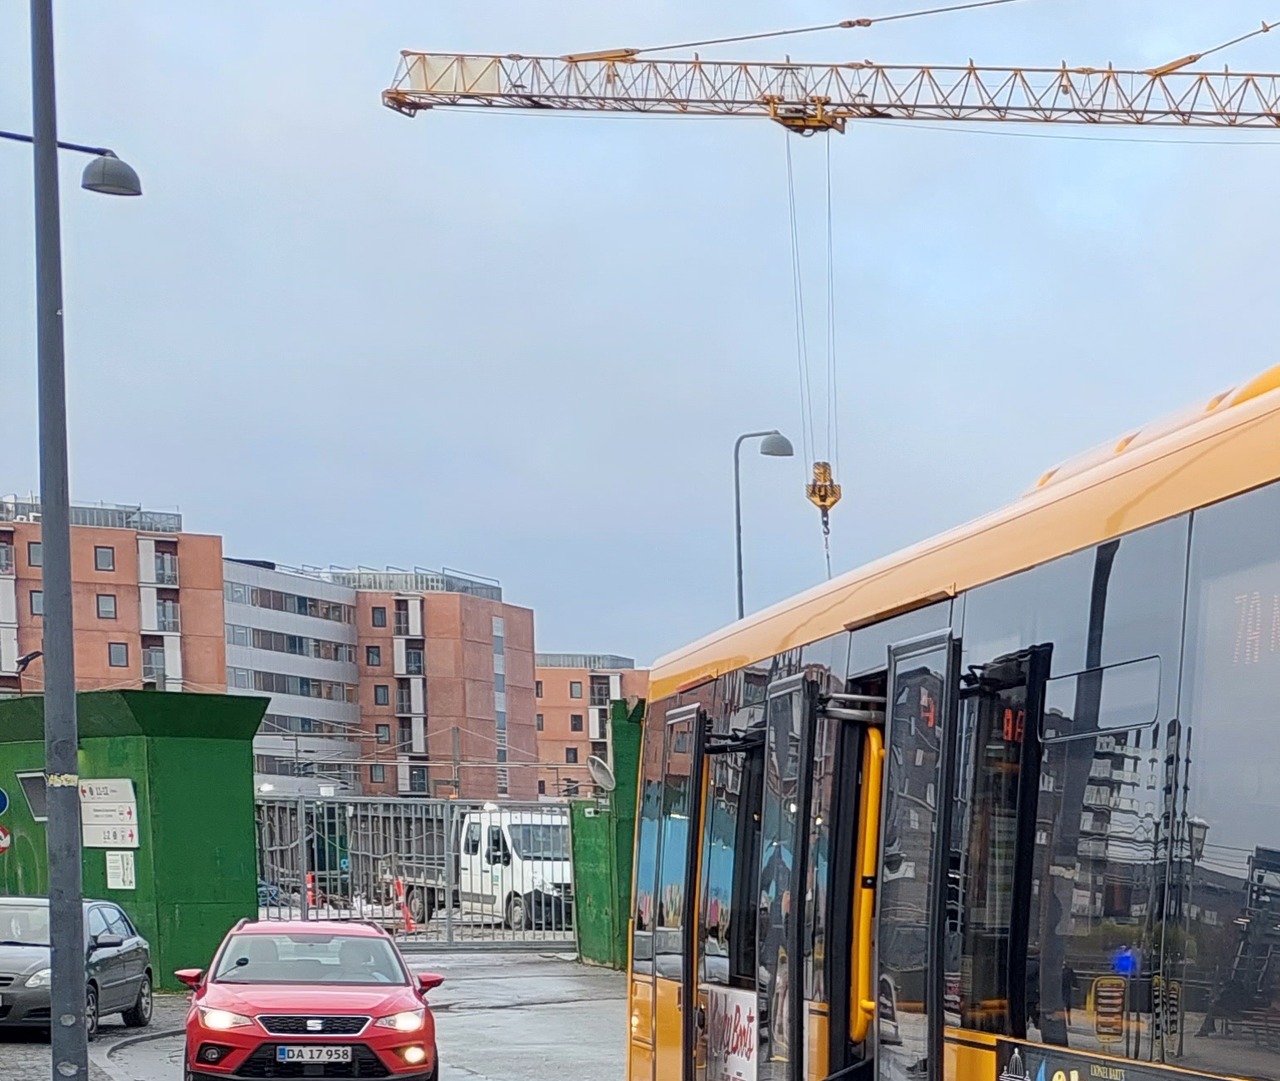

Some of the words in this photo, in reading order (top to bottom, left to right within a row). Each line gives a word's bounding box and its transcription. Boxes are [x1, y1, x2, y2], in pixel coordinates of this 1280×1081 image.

[287, 1049, 304, 1060] DA
[309, 1049, 323, 1059] 17
[325, 1049, 349, 1060] 958
